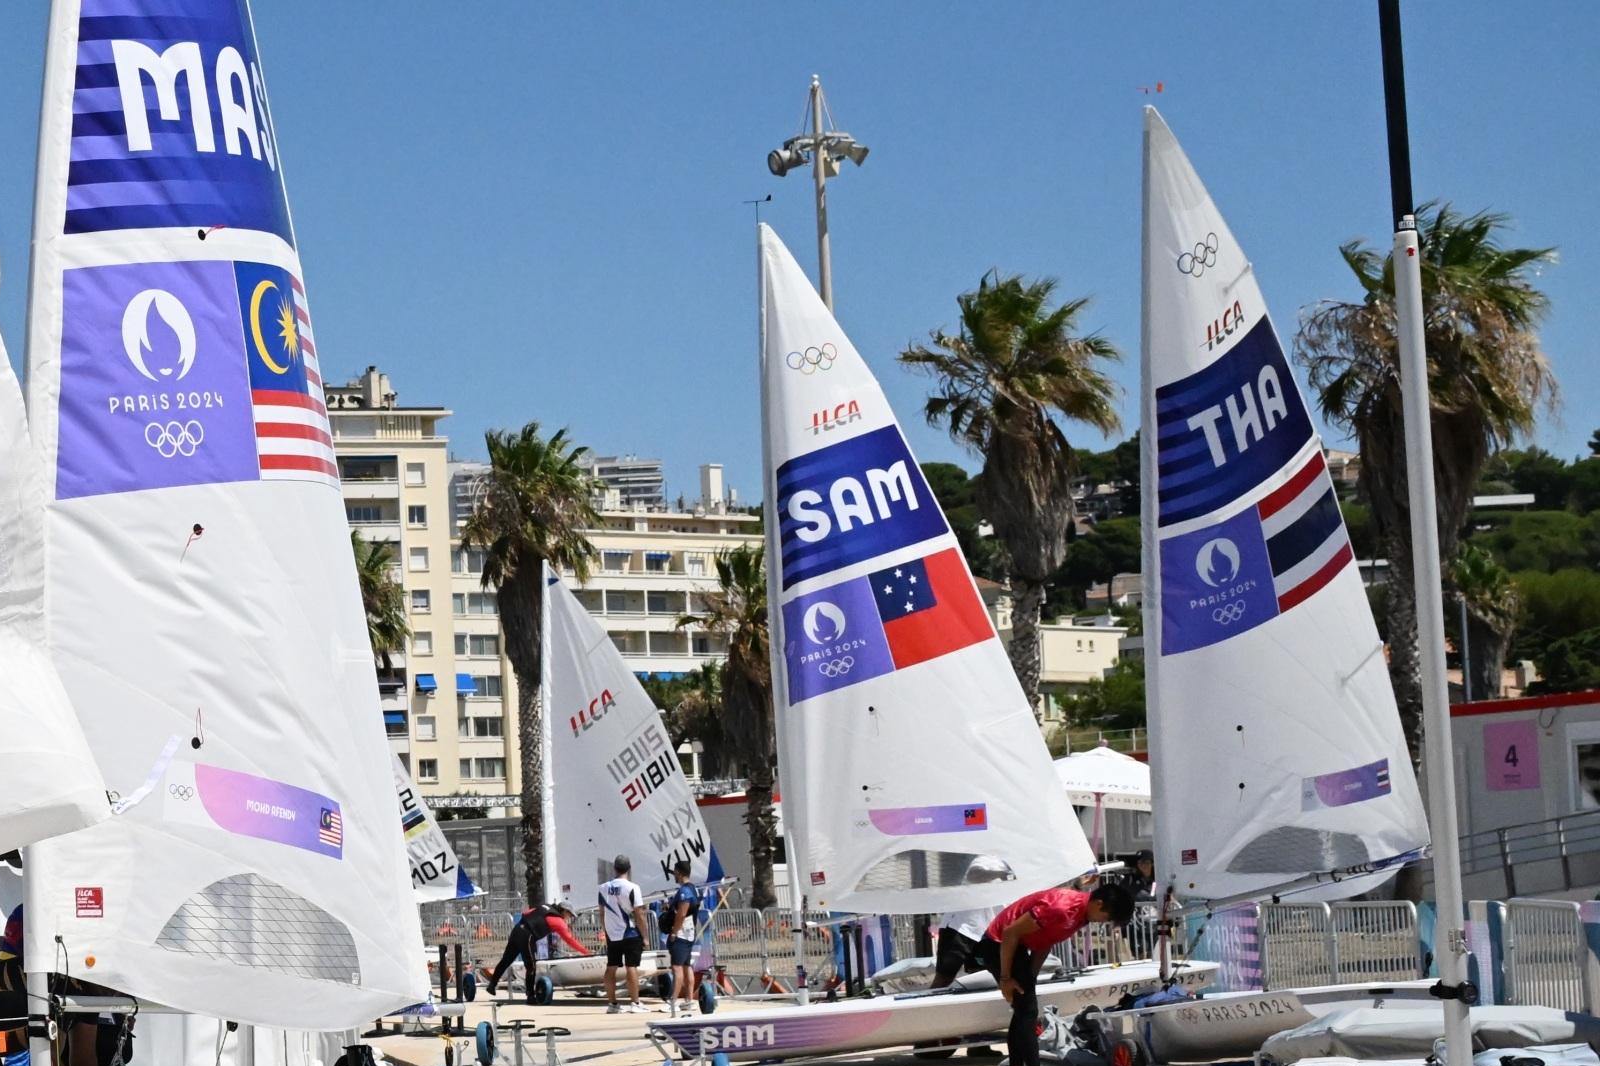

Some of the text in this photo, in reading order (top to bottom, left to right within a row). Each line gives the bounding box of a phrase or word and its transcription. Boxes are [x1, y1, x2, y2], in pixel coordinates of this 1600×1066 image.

[1203, 300, 1245, 351] ILCA
[109, 391, 223, 414] PARIS 2024
[810, 400, 862, 435] ILCA
[1187, 365, 1288, 468] THA
[788, 460, 919, 542] SAM
[1229, 580, 1256, 599] 2024
[801, 639, 867, 665] PARIS 2024
[570, 689, 617, 738] ILCA
[1505, 744, 1519, 767] 4
[621, 750, 676, 812] 211811
[247, 799, 296, 822] MOHD AFENDY
[660, 829, 706, 881] KUW
[411, 851, 455, 890] MOZ
[77, 889, 93, 897] ILCA
[1108, 979, 1157, 997] PARS
[1203, 999, 1294, 1022] PARIS 2024
[702, 1024, 774, 1050] SAM
